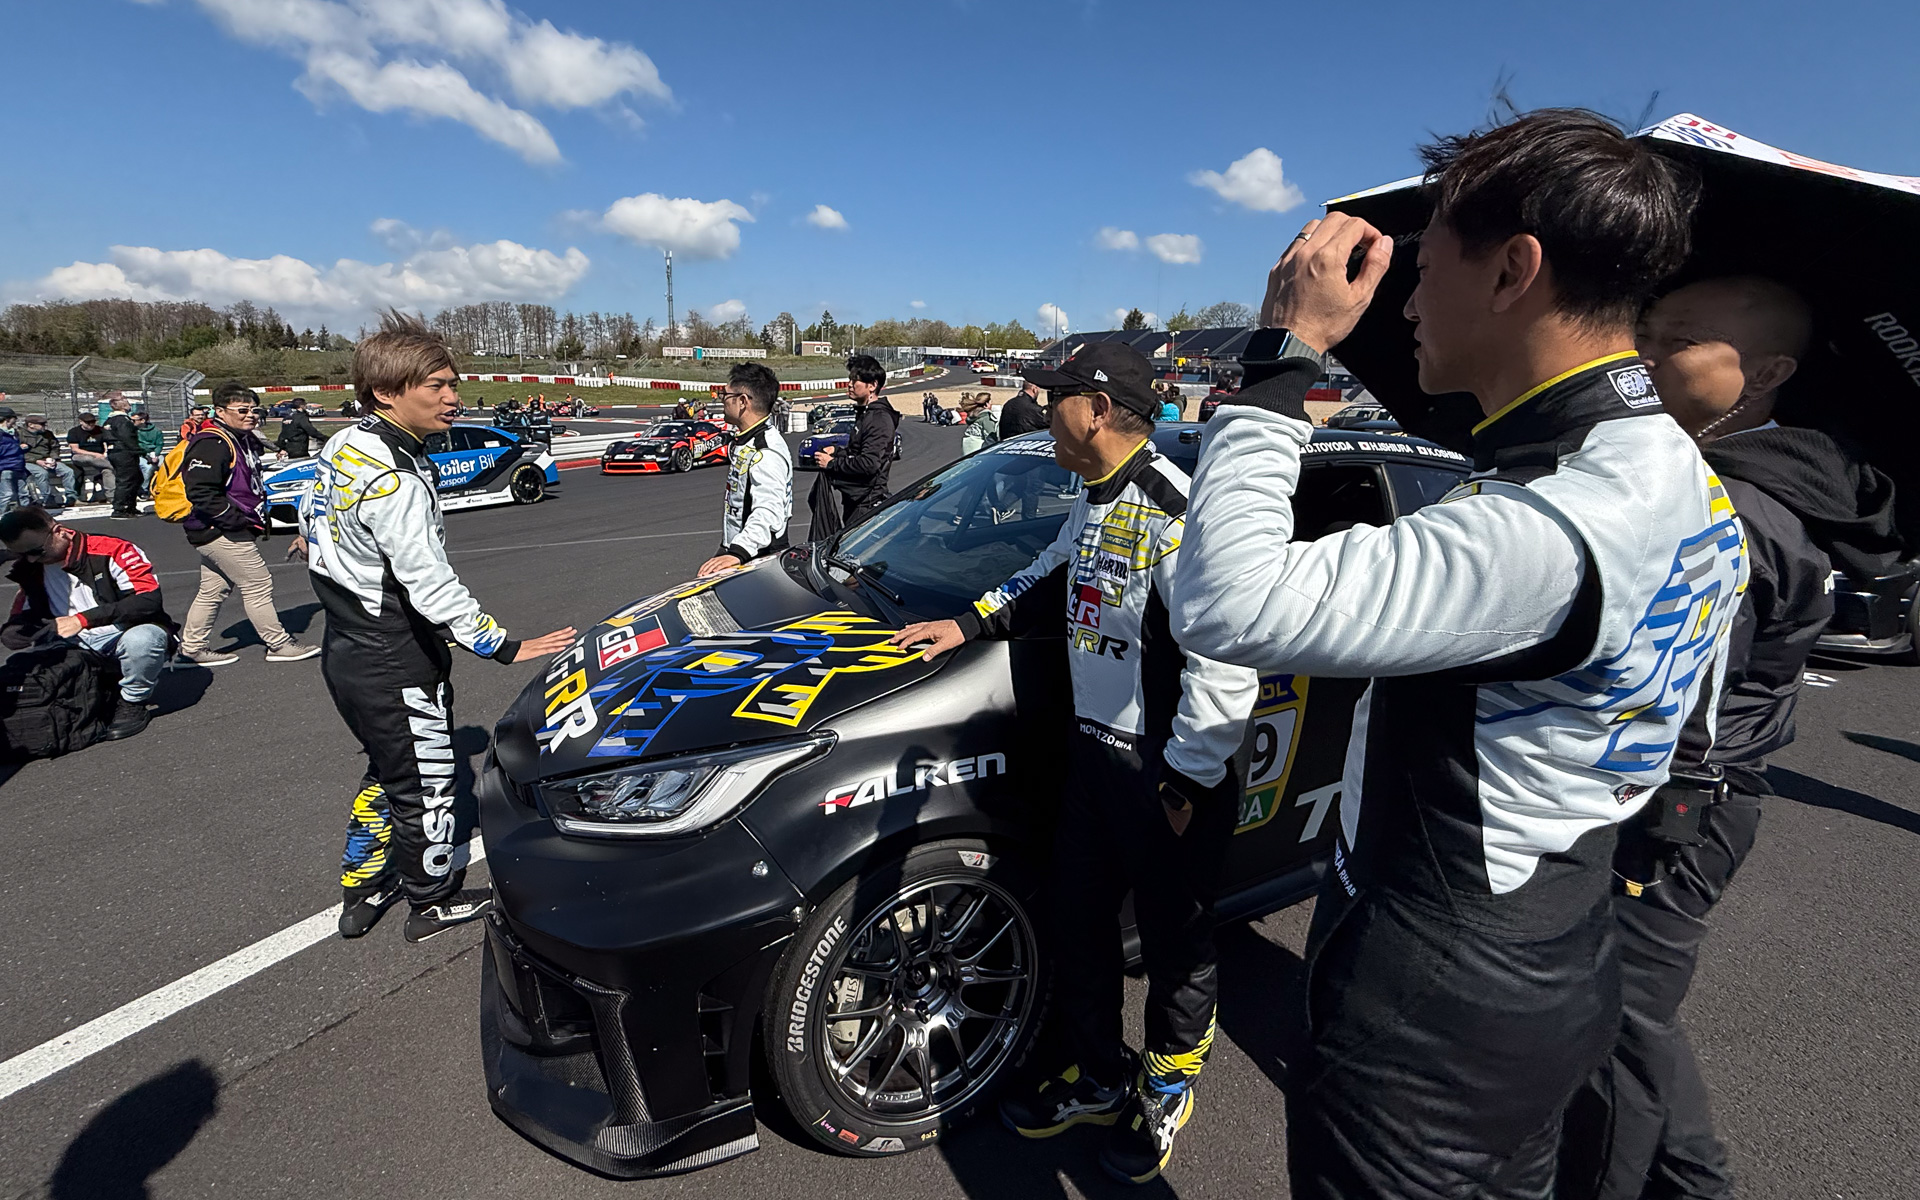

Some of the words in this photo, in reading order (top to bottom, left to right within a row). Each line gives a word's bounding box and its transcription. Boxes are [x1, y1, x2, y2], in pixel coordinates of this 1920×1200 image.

[479, 453, 495, 470] Bil
[601, 625, 640, 666] GR
[402, 682, 456, 878] OSHIMA
[787, 914, 848, 1054] BRIDGESTONE
